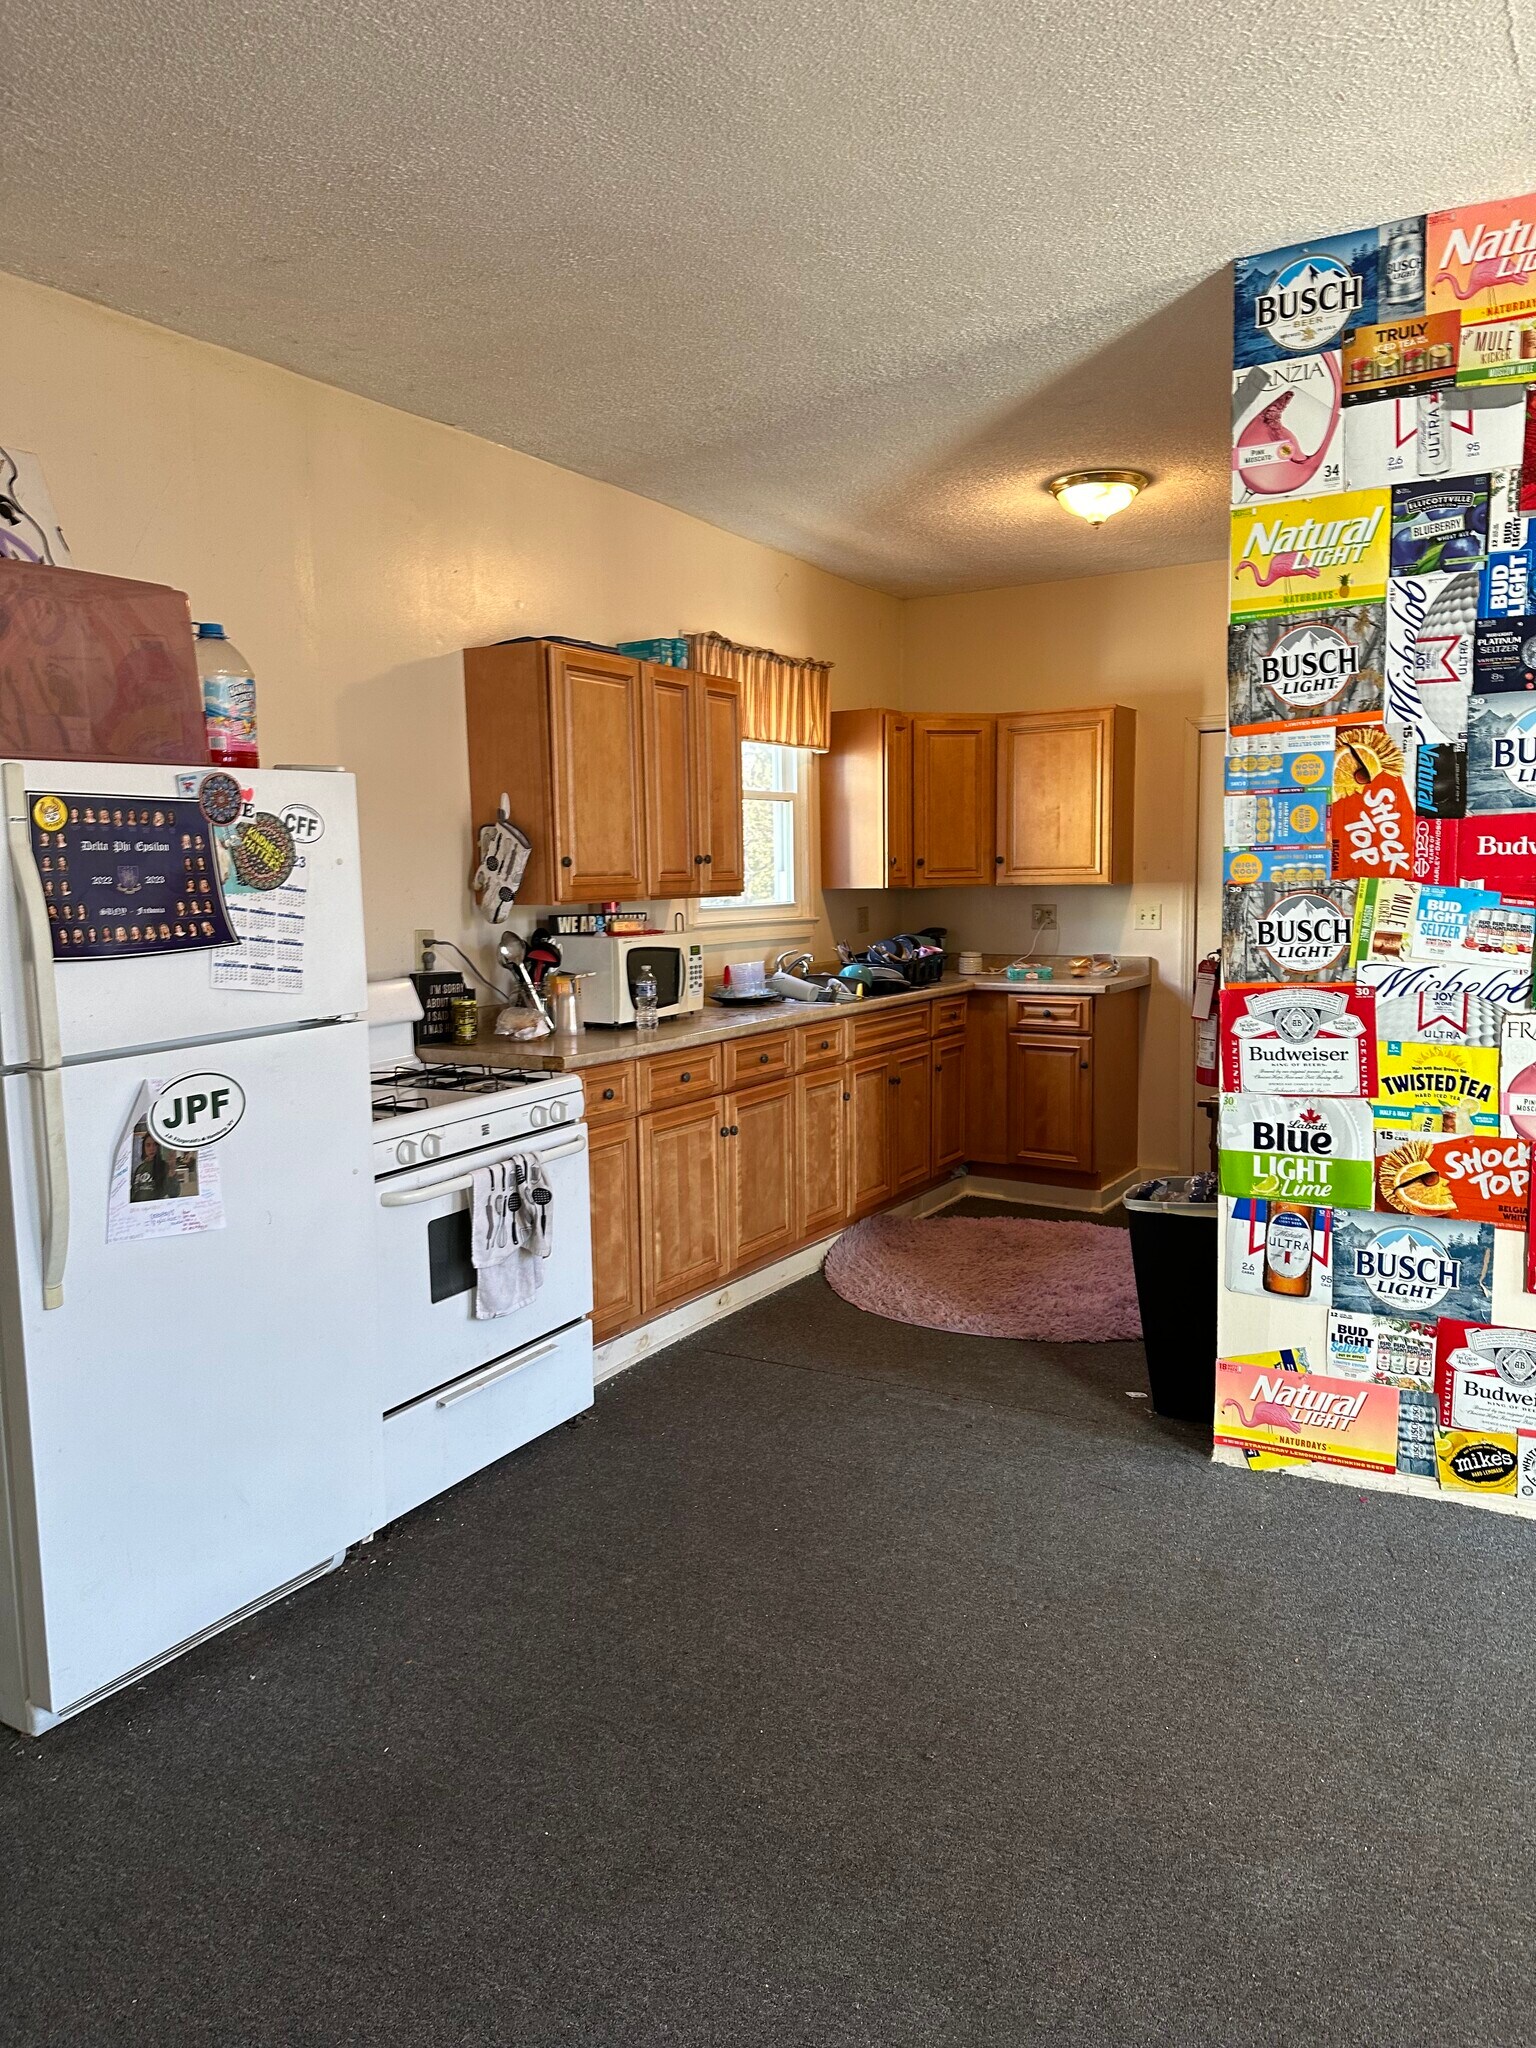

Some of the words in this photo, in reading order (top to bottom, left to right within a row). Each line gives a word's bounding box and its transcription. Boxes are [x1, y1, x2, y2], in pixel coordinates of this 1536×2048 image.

[1387, 258, 1422, 275] BUSCH
[1392, 270, 1416, 280] LIGHT
[1256, 277, 1362, 328] BUSCH
[1486, 298, 1536, 317] NATURDA
[1293, 316, 1323, 328] BEER
[1376, 322, 1428, 343] TRULY
[1474, 331, 1515, 352] MULE
[1373, 342, 1396, 354] ICED
[1481, 350, 1511, 365] KICKER
[1236, 361, 1325, 387] FNZIA
[1428, 407, 1441, 459] ULTRA
[1466, 442, 1481, 452] 95
[1245, 455, 1272, 464] MOSCATO
[1324, 464, 1340, 478] 34
[1408, 496, 1471, 511] ELLICOTTVILLE
[1242, 505, 1385, 558] Natural
[1413, 518, 1462, 537] BLUEBERRY
[1504, 521, 1513, 544] BUD
[1512, 517, 1521, 547] LIGHT
[1292, 543, 1372, 570] LIGHT
[1490, 564, 1509, 609] BUD
[1508, 555, 1527, 617] LIGHT
[1283, 591, 1333, 604] NATURDAYS
[1477, 636, 1522, 646] PLATINUM
[1480, 645, 1519, 654] SELTZER
[1387, 579, 1427, 726] Michelob
[1415, 652, 1426, 671] JOY
[1458, 640, 1469, 675] ULTRA
[1261, 646, 1359, 684] BUSCH
[1283, 677, 1339, 694] LIGHT
[1284, 720, 1310, 728] LIMITED
[1312, 717, 1338, 725] EDITION
[1403, 725, 1412, 738] 15
[285, 813, 319, 837] CFF
[1363, 788, 1410, 875] SHOCK
[80, 840, 109, 851] Delta
[113, 841, 131, 853] Phi
[135, 842, 170, 853] Epsilon
[246, 826, 287, 863] KINDNESS
[1344, 811, 1380, 865] TOP
[241, 835, 282, 872] MATTERS
[1332, 839, 1340, 871] BELGIAN
[91, 875, 113, 886] 2022
[145, 875, 166, 885] 2023
[1378, 899, 1390, 926] KICKER
[1391, 893, 1412, 928] MULE
[1427, 899, 1462, 912] BUD
[557, 916, 578, 933] WE
[580, 916, 598, 932] AR
[1419, 910, 1467, 925] LIGHT
[1256, 918, 1352, 946] BUSCH
[1420, 922, 1460, 939] SELTZER
[1278, 946, 1333, 958] LIGHT
[430, 984, 441, 995] I'M
[442, 983, 464, 994] SORRY
[1355, 988, 1369, 996] 30
[1362, 964, 1534, 1003] Michelob
[426, 997, 449, 1008] ABOUT
[1432, 992, 1456, 1001] JOY
[427, 1011, 431, 1021] I
[432, 1010, 449, 1021] SAID
[423, 1024, 427, 1035] I
[429, 1023, 443, 1034] WAS
[1424, 1030, 1461, 1040] ULTRA
[1507, 1021, 1536, 1040] FR
[1249, 1046, 1349, 1061] Budweiser
[1231, 1040, 1240, 1093] GENUINE
[1360, 1039, 1369, 1095] GENUINE
[1381, 1073, 1456, 1095] TWISTED
[1459, 1075, 1492, 1102] TEA
[162, 1088, 231, 1129] JPF
[1223, 1096, 1234, 1105] 30
[1287, 1120, 1328, 1131] Labatt
[1253, 1122, 1332, 1155] Blue
[1380, 1131, 1393, 1140] 15
[1253, 1155, 1333, 1183] LIGHT
[1281, 1178, 1333, 1197] Lime
[1468, 1170, 1530, 1200] TOP
[1269, 1237, 1310, 1251] ULTRA
[1355, 1249, 1461, 1289] BUSCH
[1321, 1275, 1333, 1283] 95
[1377, 1281, 1437, 1300] LIGHT
[1337, 1324, 1368, 1337] BUD
[1331, 1333, 1374, 1348] LIGHT
[1331, 1341, 1371, 1354] Seltzer
[1250, 1375, 1368, 1418] Natural
[1443, 1370, 1452, 1425] GENUINE
[1291, 1410, 1356, 1431] LIGHT
[1245, 1441, 1289, 1454] STRAWBERRY
[1290, 1450, 1326, 1461] LEMONADE
[1280, 1435, 1327, 1451] NATURDAYS
[1455, 1451, 1513, 1472] mike's
